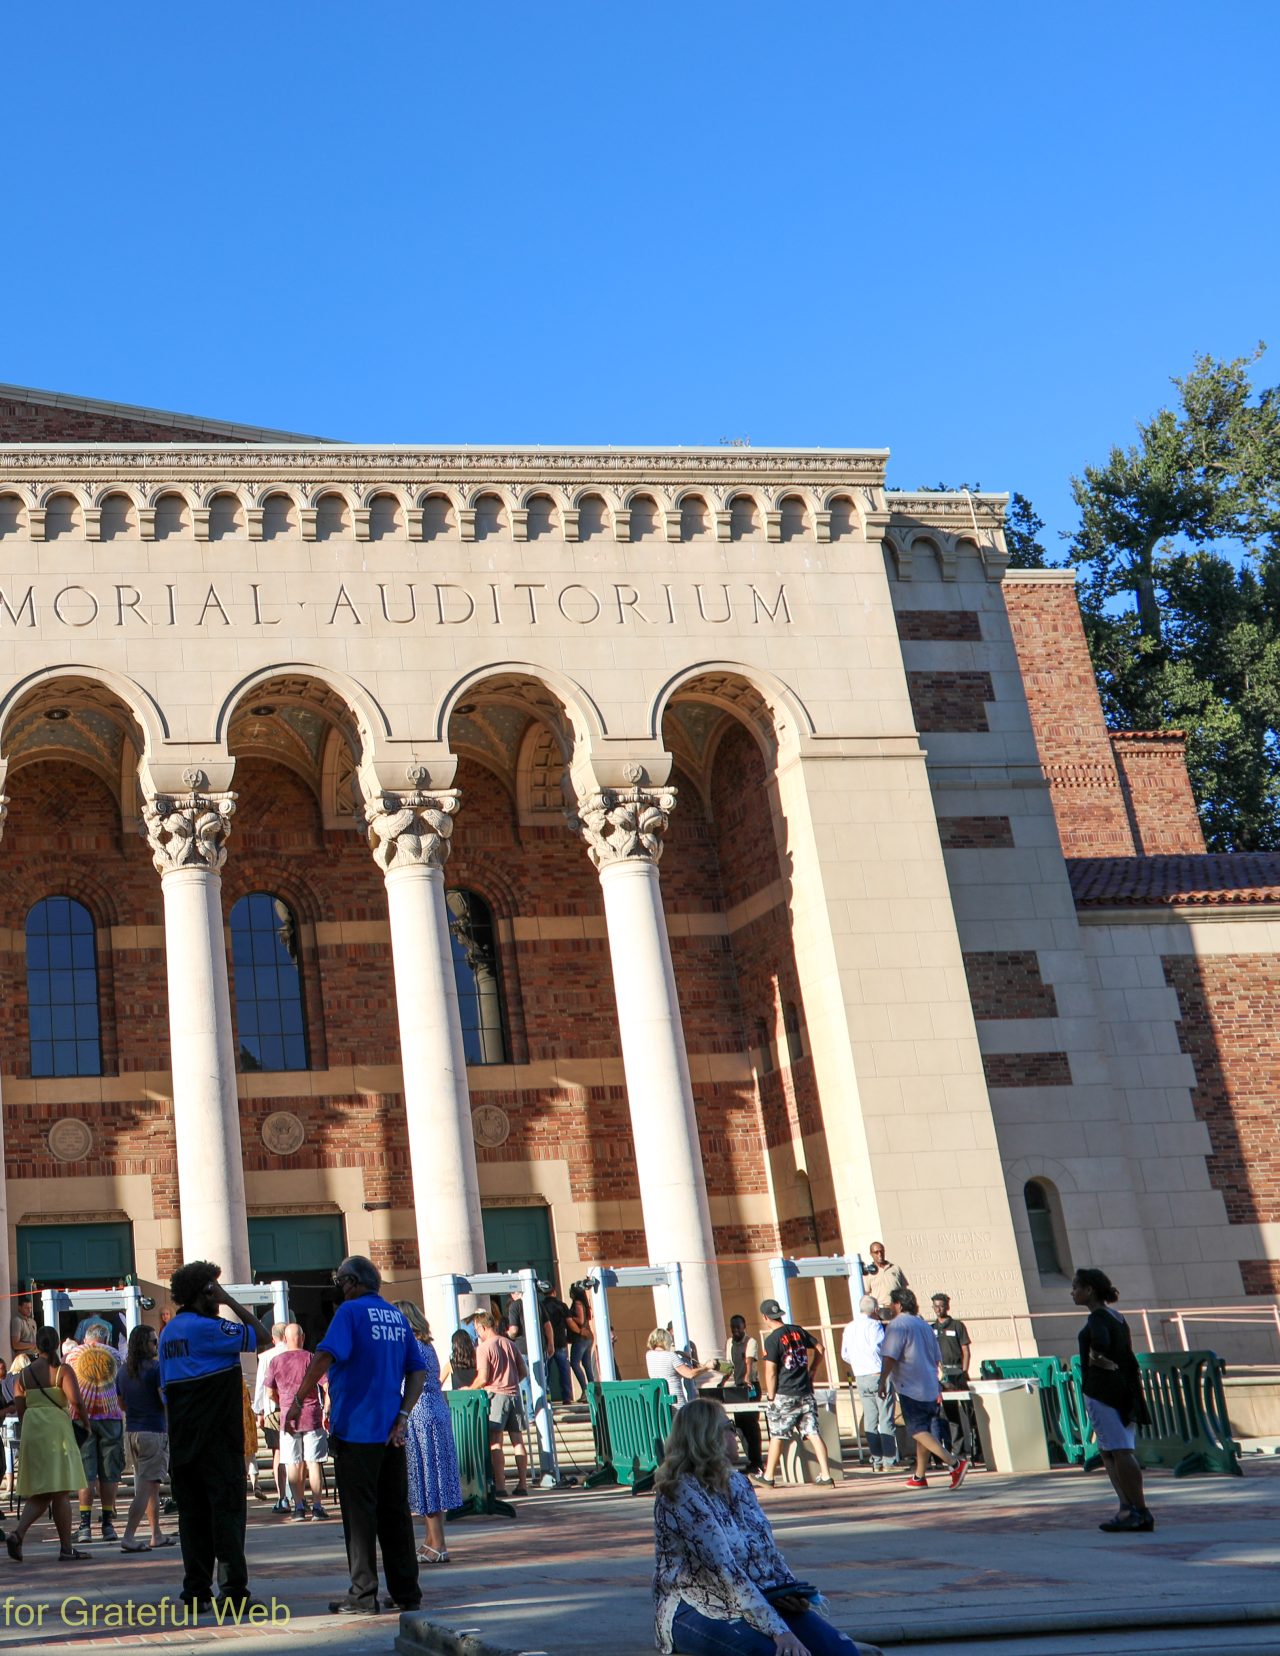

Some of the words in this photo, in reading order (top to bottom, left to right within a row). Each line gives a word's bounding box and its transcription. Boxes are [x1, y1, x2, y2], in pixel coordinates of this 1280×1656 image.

[325, 583, 795, 626] AUDITORIUM
[367, 1308, 403, 1325] EVENT
[372, 1325, 406, 1343] STAFF
